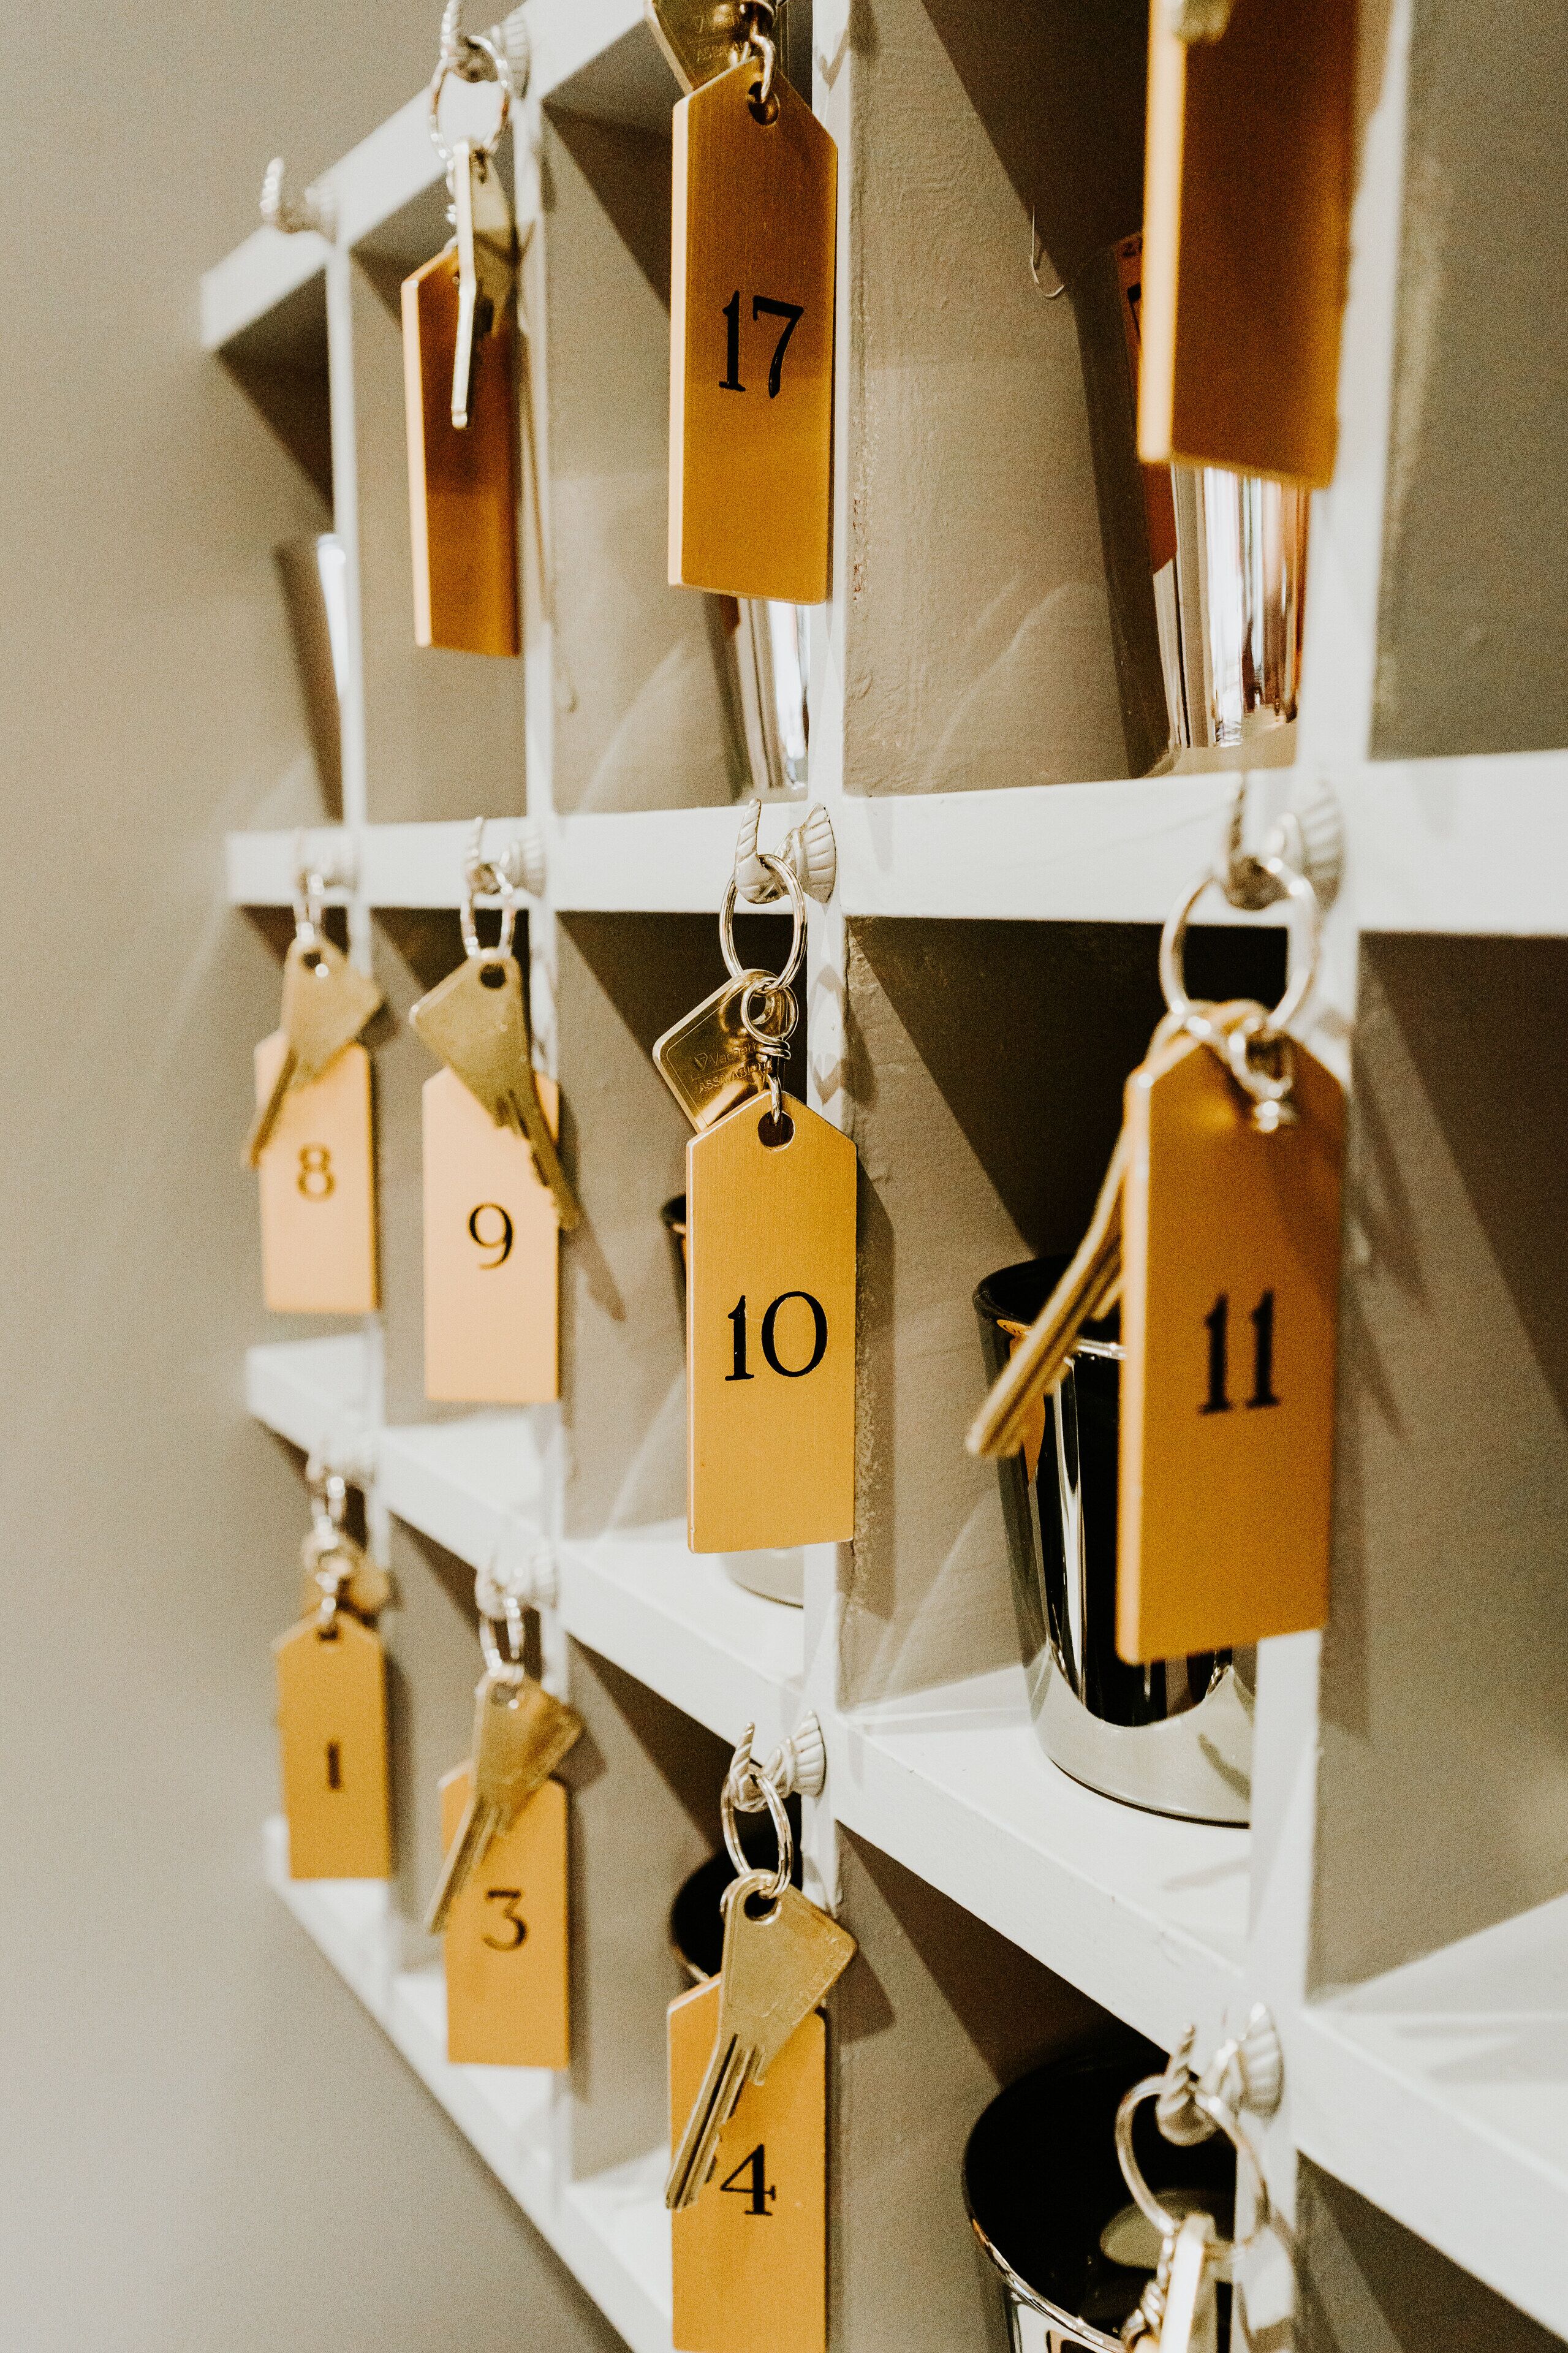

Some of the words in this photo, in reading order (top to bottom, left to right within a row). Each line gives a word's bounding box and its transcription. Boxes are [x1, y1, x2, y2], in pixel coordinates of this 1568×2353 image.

[718, 289, 805, 399] 17
[297, 1143, 336, 1202] 8
[467, 1202, 515, 1270] 9
[724, 1290, 828, 1381] 10
[1199, 1288, 1281, 1414] 11
[326, 1741, 343, 1790] 1
[481, 1888, 528, 1951] 3
[720, 2143, 776, 2216] 4
